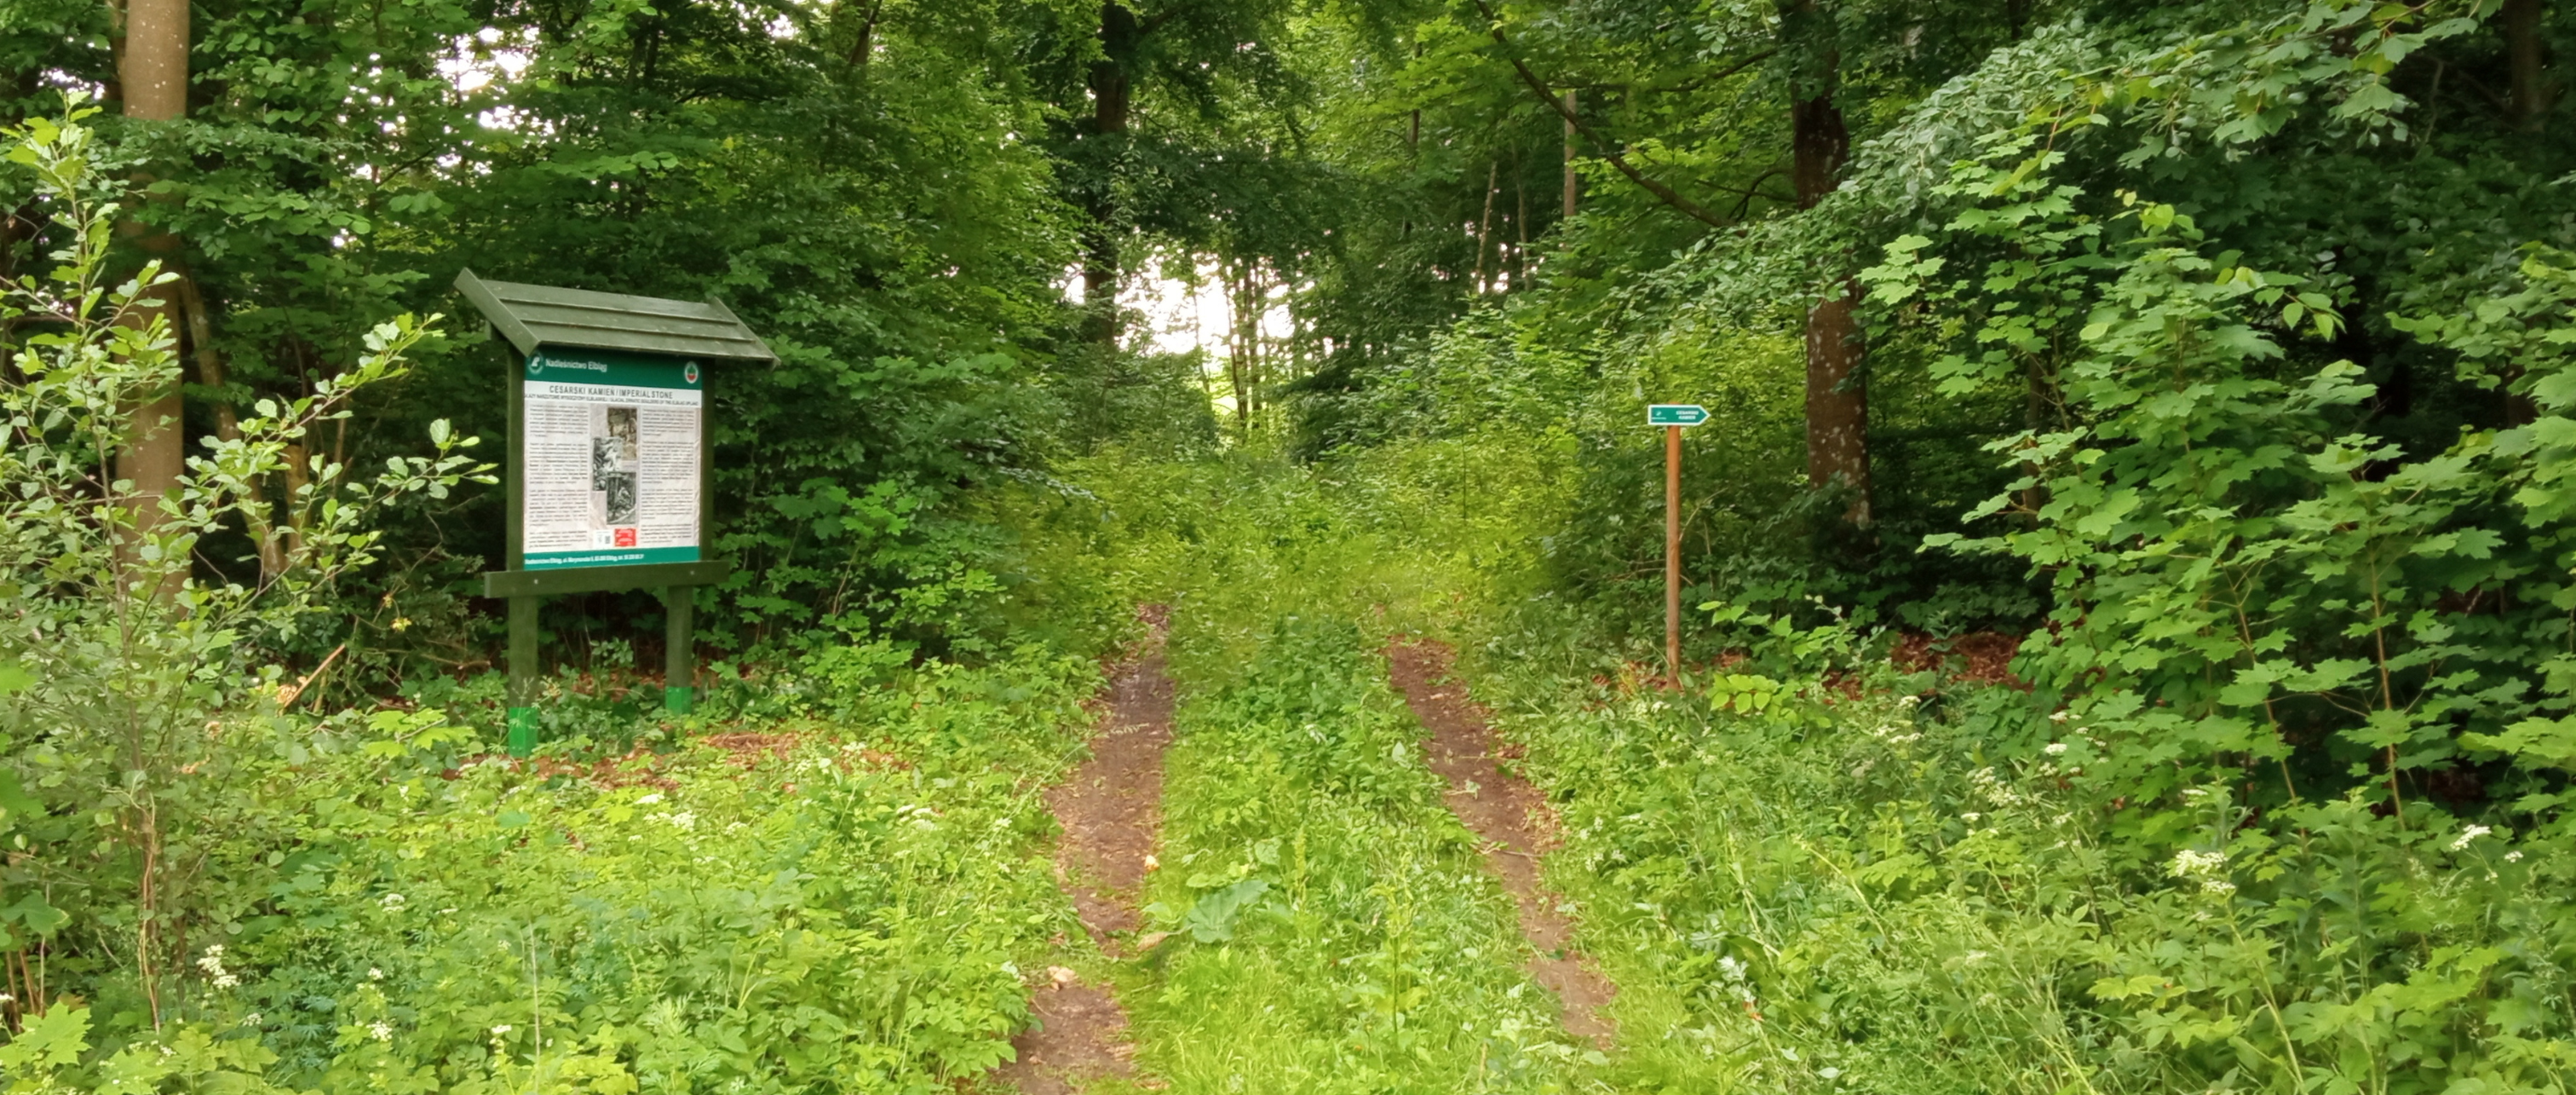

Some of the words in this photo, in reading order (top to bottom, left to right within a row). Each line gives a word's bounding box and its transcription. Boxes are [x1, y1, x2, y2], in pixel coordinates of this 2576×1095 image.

[545, 359, 587, 369] Nadleśnictwo
[588, 360, 607, 372] Elbląg
[549, 385, 585, 395] CESARSKI
[588, 387, 614, 396] KAMIEŃ
[619, 389, 651, 398] IMPERIAL
